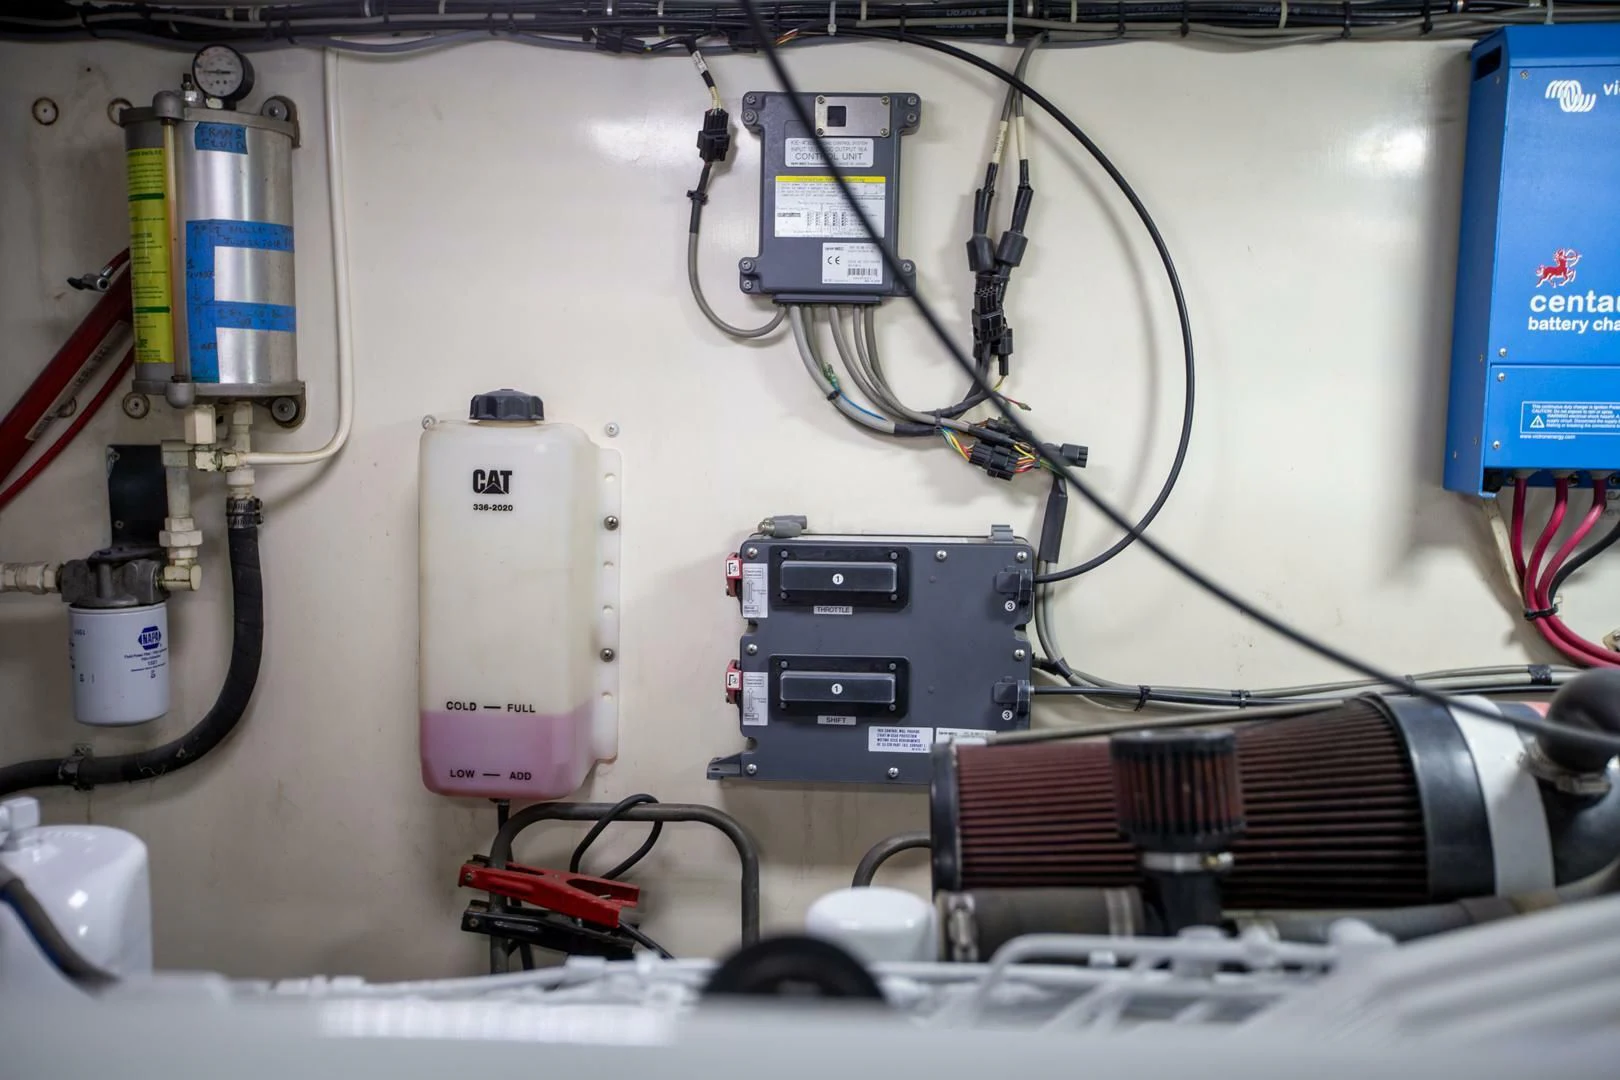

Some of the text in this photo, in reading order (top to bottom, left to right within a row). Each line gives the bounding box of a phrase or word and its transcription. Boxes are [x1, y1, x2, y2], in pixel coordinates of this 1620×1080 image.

[1603, 80, 1620, 96] vi
[1530, 289, 1620, 313] centa
[1528, 316, 1589, 334] battery
[473, 469, 512, 494] CAT
[142, 630, 160, 645] NAPA
[446, 701, 536, 713] COLD FULL
[450, 769, 532, 780] LOW ADD
